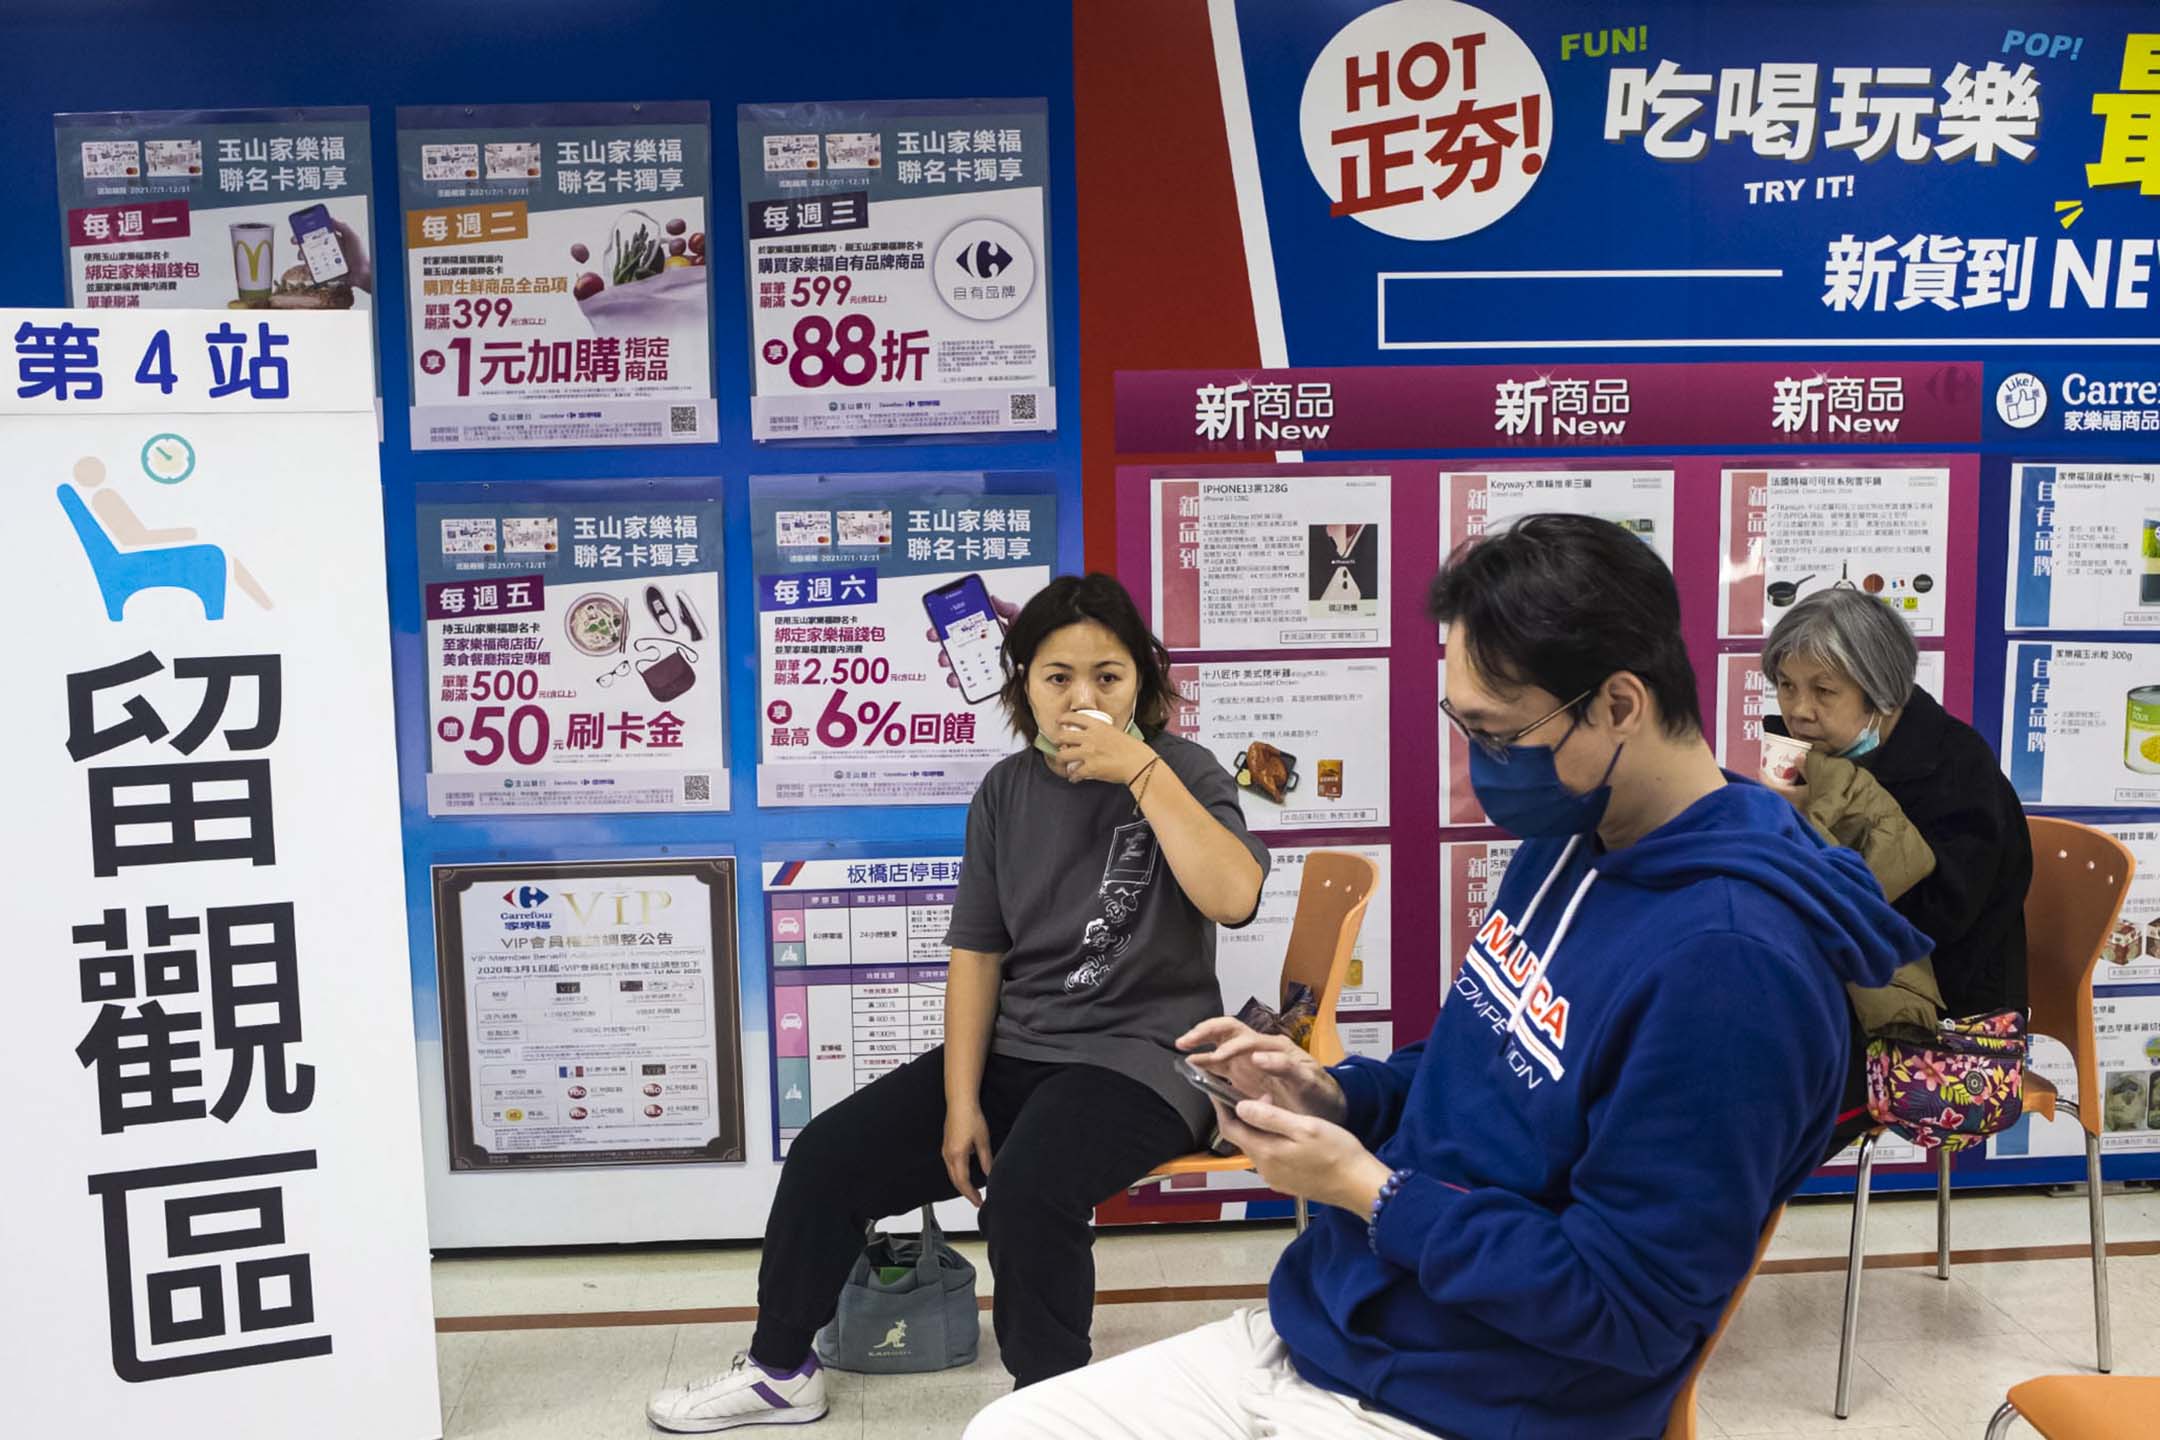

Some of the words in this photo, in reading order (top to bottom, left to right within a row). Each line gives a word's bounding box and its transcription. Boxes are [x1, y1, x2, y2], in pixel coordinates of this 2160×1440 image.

[1560, 26, 1649, 62] FUN!
[2002, 28, 2083, 62] POP!
[1344, 31, 1487, 113] HOT
[1603, 59, 2044, 164] 吃喝玩樂
[218, 136, 346, 163] 玉山家樂福
[557, 138, 682, 165] 玉山家樂福
[897, 129, 1022, 155] 玉山家樂福
[1329, 93, 1543, 217] 正夯!
[219, 166, 347, 192] 聯名卡獨享
[557, 168, 684, 194] 聯名卡獨享
[897, 158, 1023, 184] 聯名卡獨享
[1745, 179, 1806, 205] TRY
[1816, 175, 1855, 200] IT!
[83, 210, 178, 239] 每週一
[422, 211, 517, 241] 每週二
[763, 200, 857, 232] 每週三
[85, 262, 200, 280] 綁定家樂福錢包
[758, 253, 925, 274] 購買家樂福自有品牌商品
[1822, 234, 2038, 313] 新貨到
[2050, 238, 2160, 309] NE
[424, 277, 568, 296] 購買生鮮商品全品項
[790, 275, 853, 307] 599
[953, 286, 1017, 300] 自有品牌
[452, 298, 513, 329] 399
[625, 338, 670, 360] 指定
[789, 314, 930, 388] 88折
[448, 337, 621, 397] 1元加購
[625, 360, 669, 382] 商品
[2005, 375, 2036, 392] Like!
[2062, 373, 2160, 405] Carre
[1254, 420, 1331, 442] New
[1553, 417, 1627, 437] New
[1828, 415, 1901, 434] New
[2064, 410, 2160, 431] 家樂福商品
[573, 516, 699, 541] 玉山家樂福
[907, 509, 1031, 533] 玉山家樂福
[574, 543, 699, 568] 聯名卡獨享
[907, 537, 1031, 562] 聯名卡獨享
[440, 582, 533, 613] 每週五
[774, 574, 866, 605] 每週六
[775, 626, 886, 643] 綁定家樂福錢包
[443, 652, 551, 667] 美食餐廳指定專櫃
[2111, 651, 2133, 661] 300g
[802, 657, 889, 686] 2,500
[470, 669, 539, 702] 500
[816, 688, 976, 748] 6%回饋
[771, 728, 810, 747] 最高
[500, 912, 552, 920] Carrefour
[560, 889, 672, 926] VIP
[63, 649, 334, 1386] 留觀區
